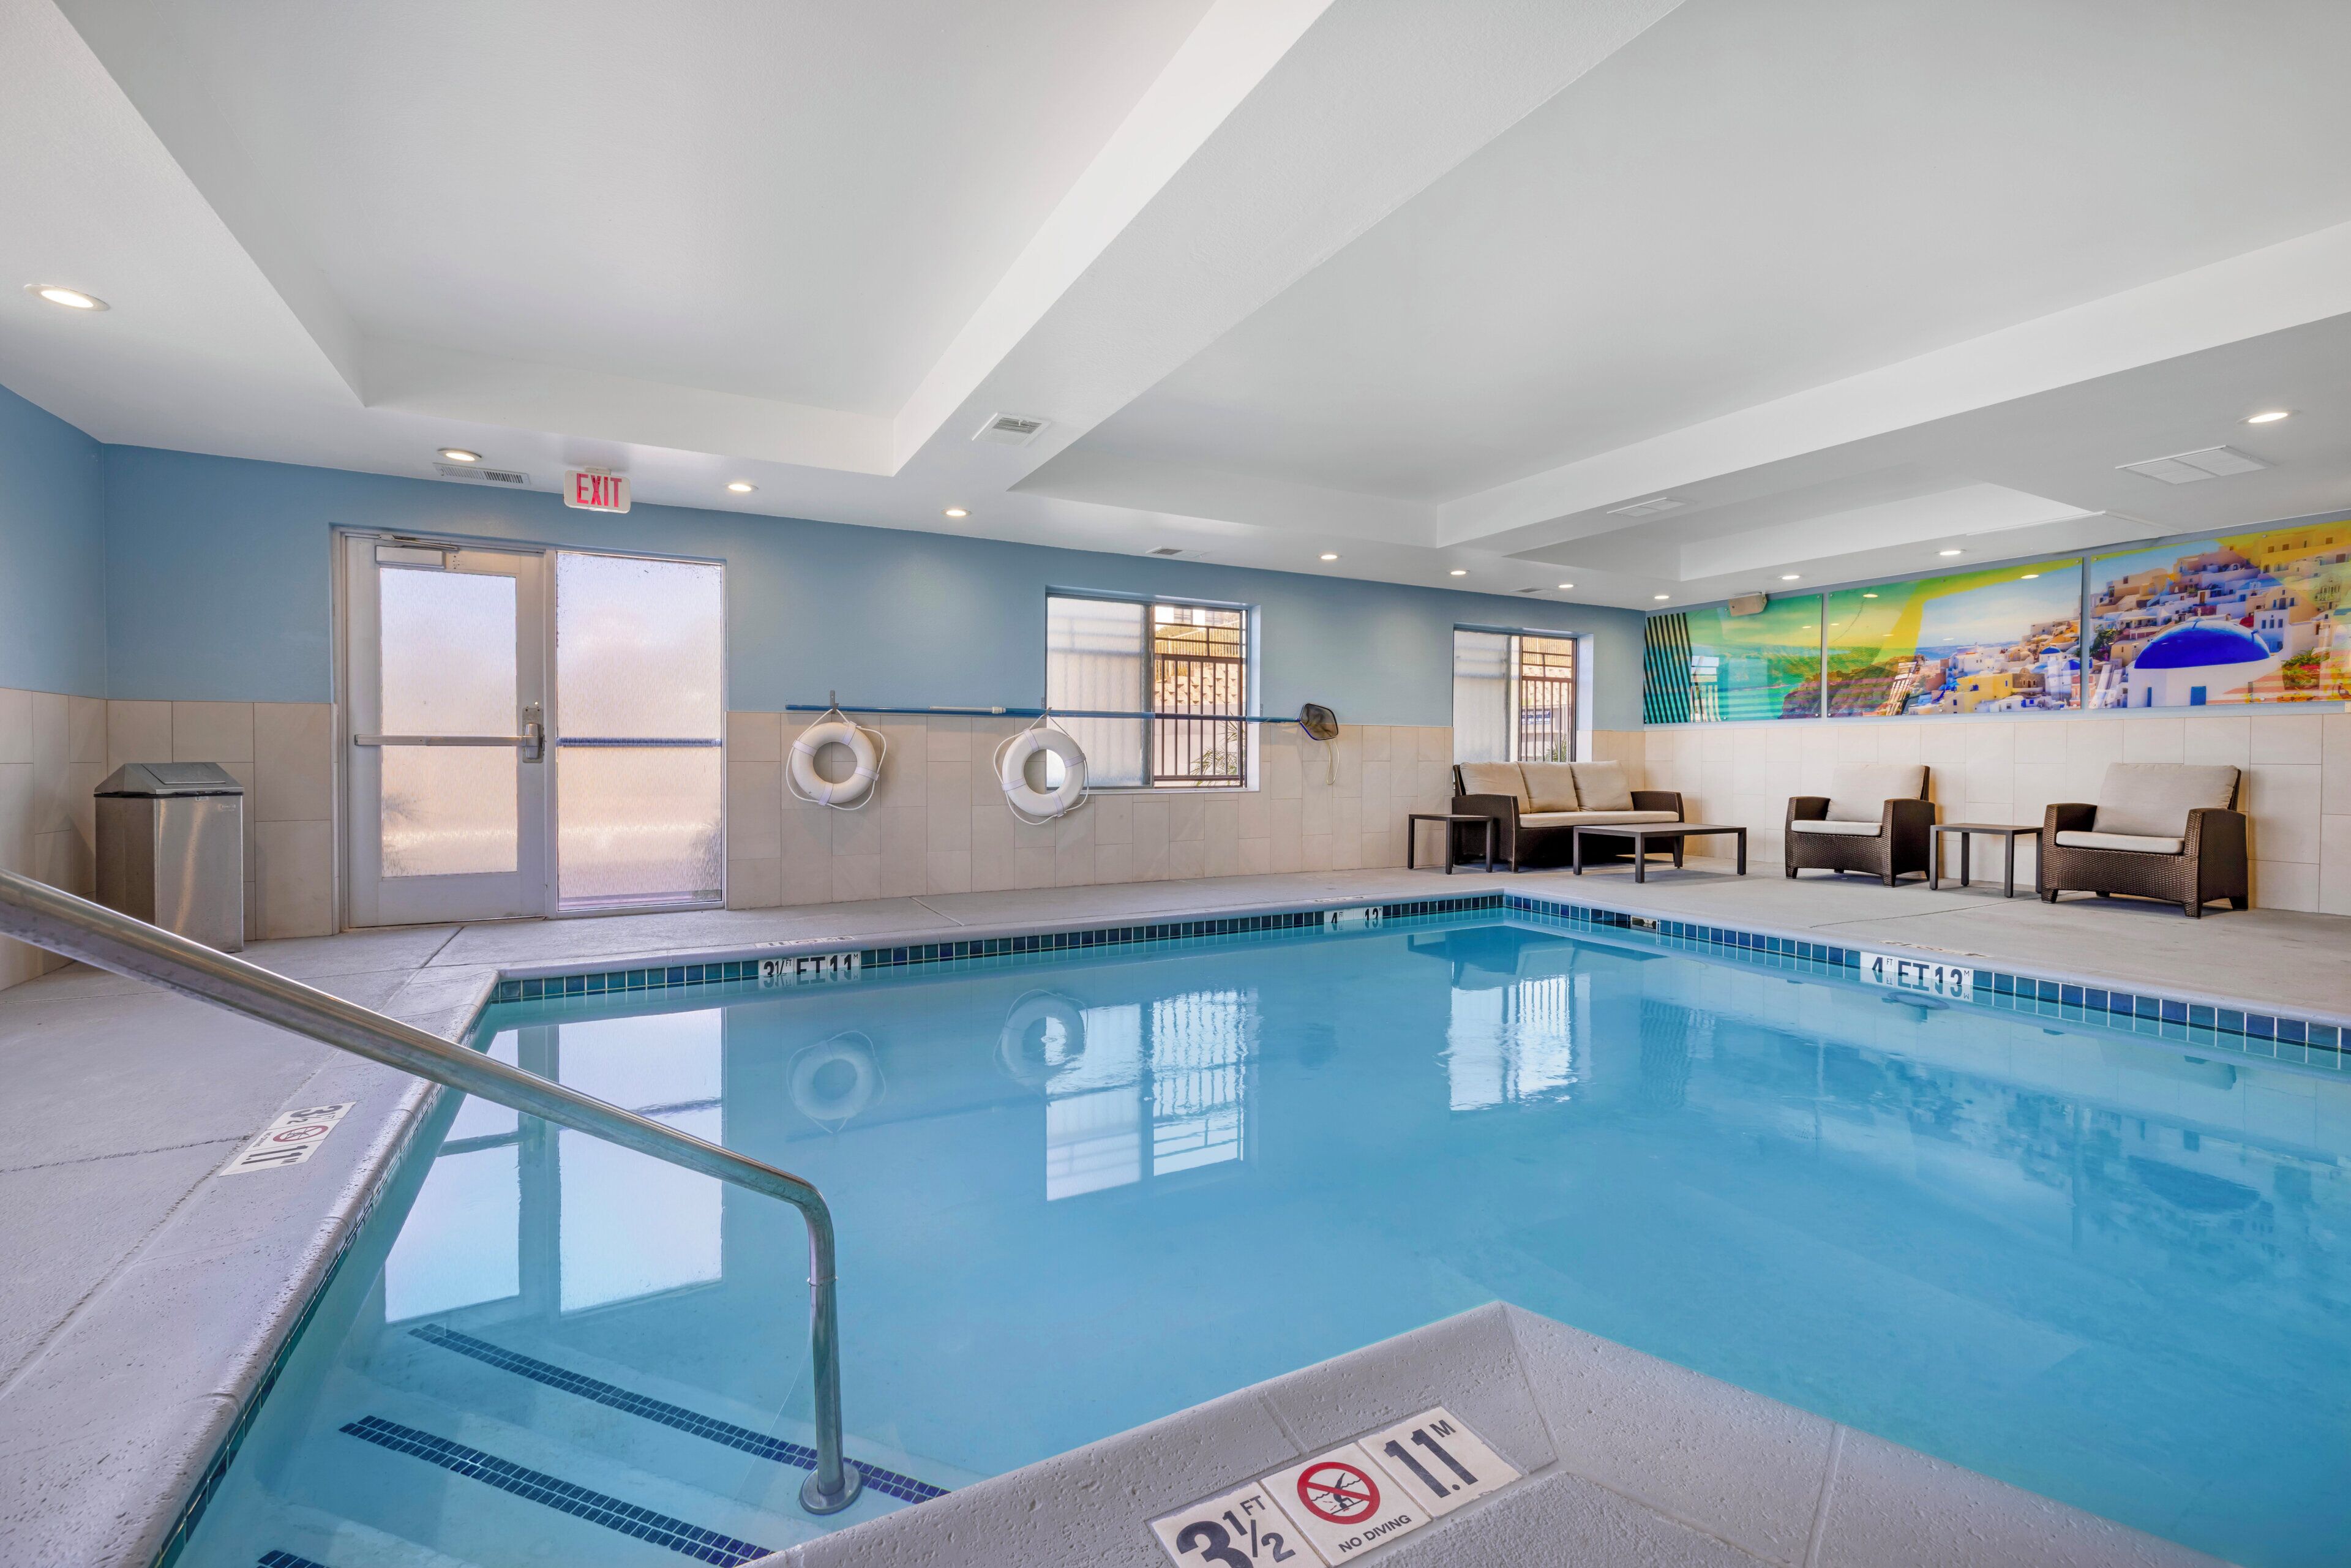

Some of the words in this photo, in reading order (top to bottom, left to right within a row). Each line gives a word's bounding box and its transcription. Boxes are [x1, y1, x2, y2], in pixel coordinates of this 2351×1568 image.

[577, 473, 622, 508] EXIT
[241, 1145, 309, 1166] 1.1
[1429, 1419, 1457, 1438] M
[1383, 1429, 1479, 1498] 1.1
[1240, 1495, 1267, 1516] FT
[1338, 1534, 1363, 1553] NO
[1362, 1514, 1412, 1543] DIVING
